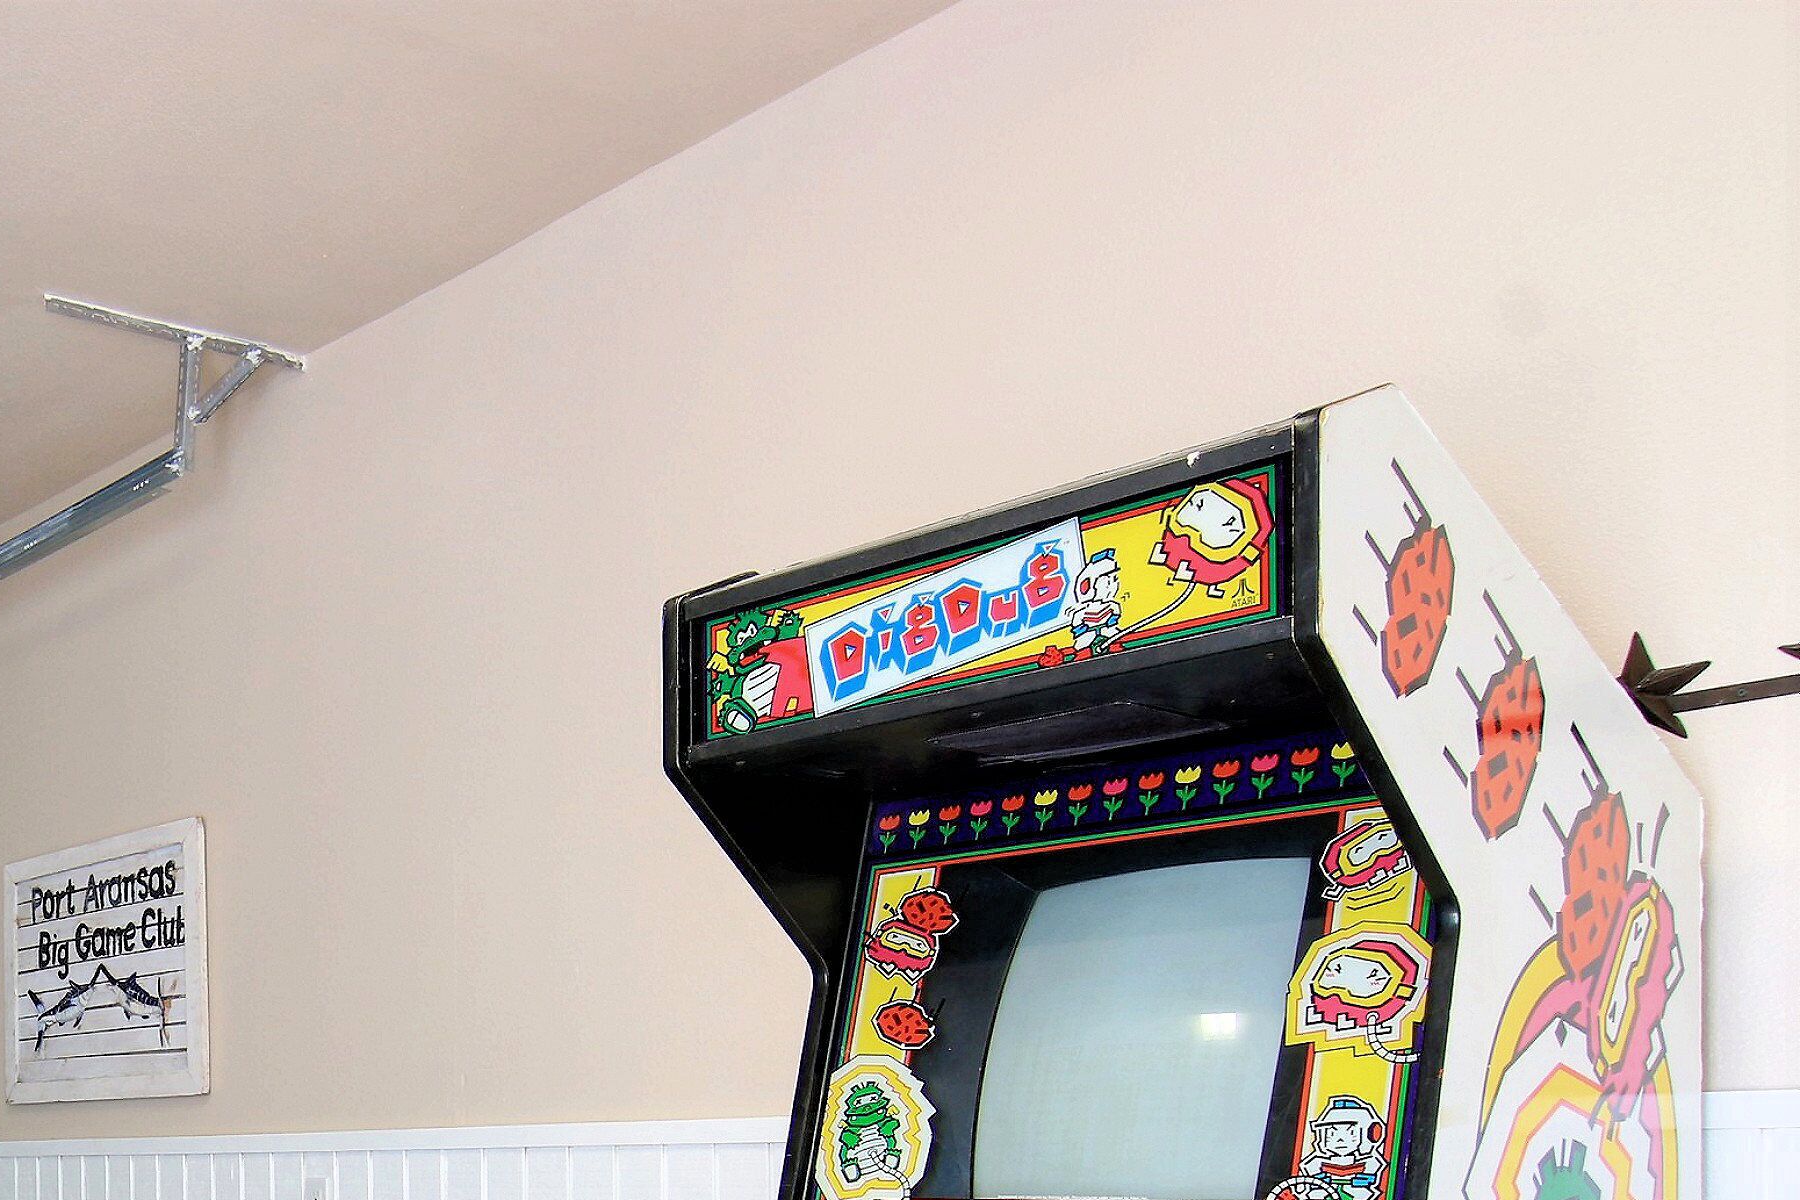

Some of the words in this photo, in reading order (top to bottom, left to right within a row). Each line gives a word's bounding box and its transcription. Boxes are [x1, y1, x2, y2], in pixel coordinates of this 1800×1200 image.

[32, 879, 75, 923] Port
[83, 859, 176, 914] Aransas
[38, 931, 69, 979] Big
[75, 922, 136, 961] Game
[141, 905, 186, 948] Club
